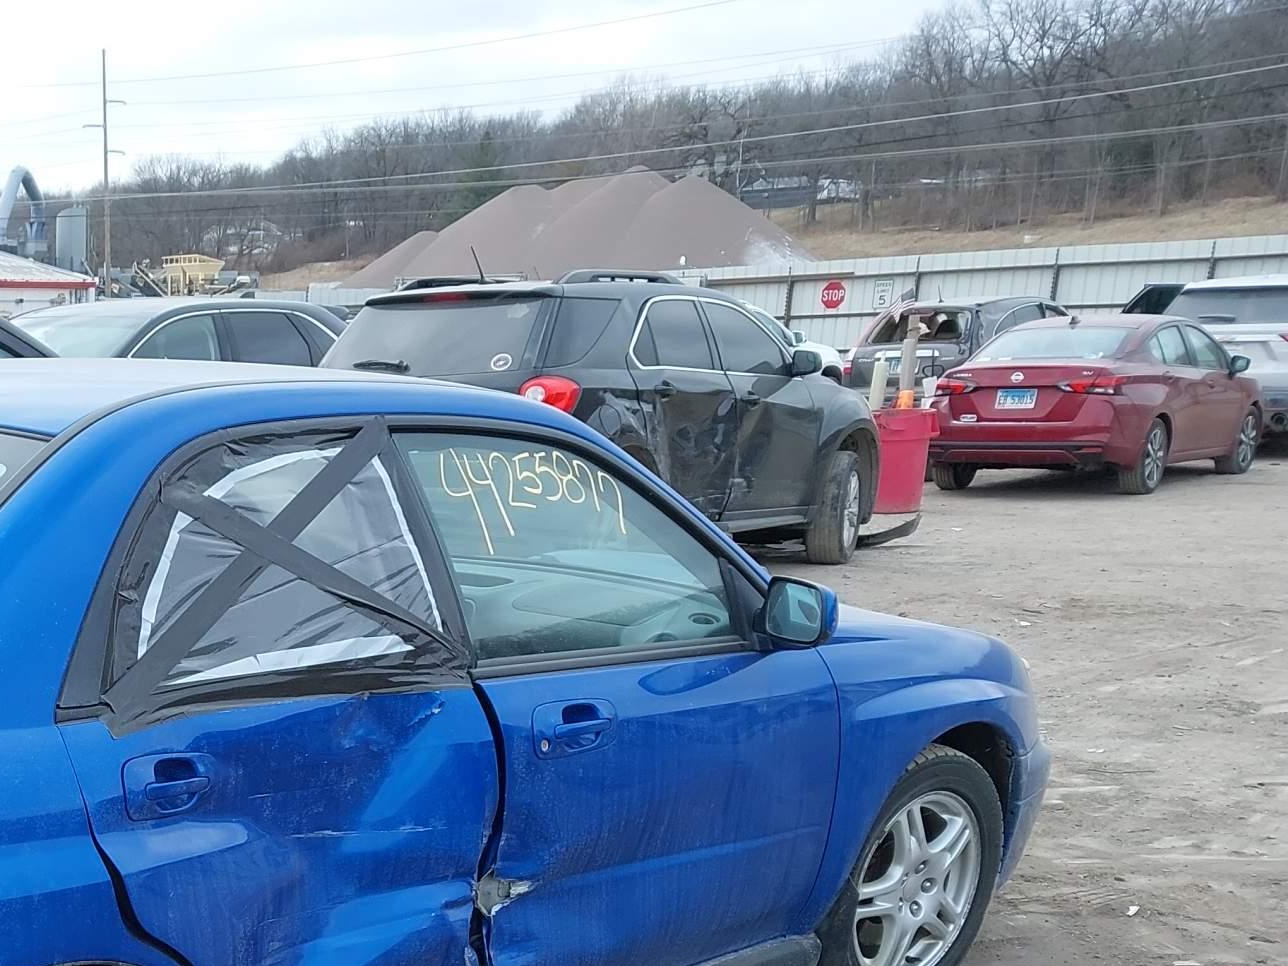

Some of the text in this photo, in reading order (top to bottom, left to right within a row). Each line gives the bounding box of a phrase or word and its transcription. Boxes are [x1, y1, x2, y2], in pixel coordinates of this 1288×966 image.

[822, 290, 845, 301] STOP
[878, 294, 886, 305] 5
[439, 448, 627, 555] 44255877
